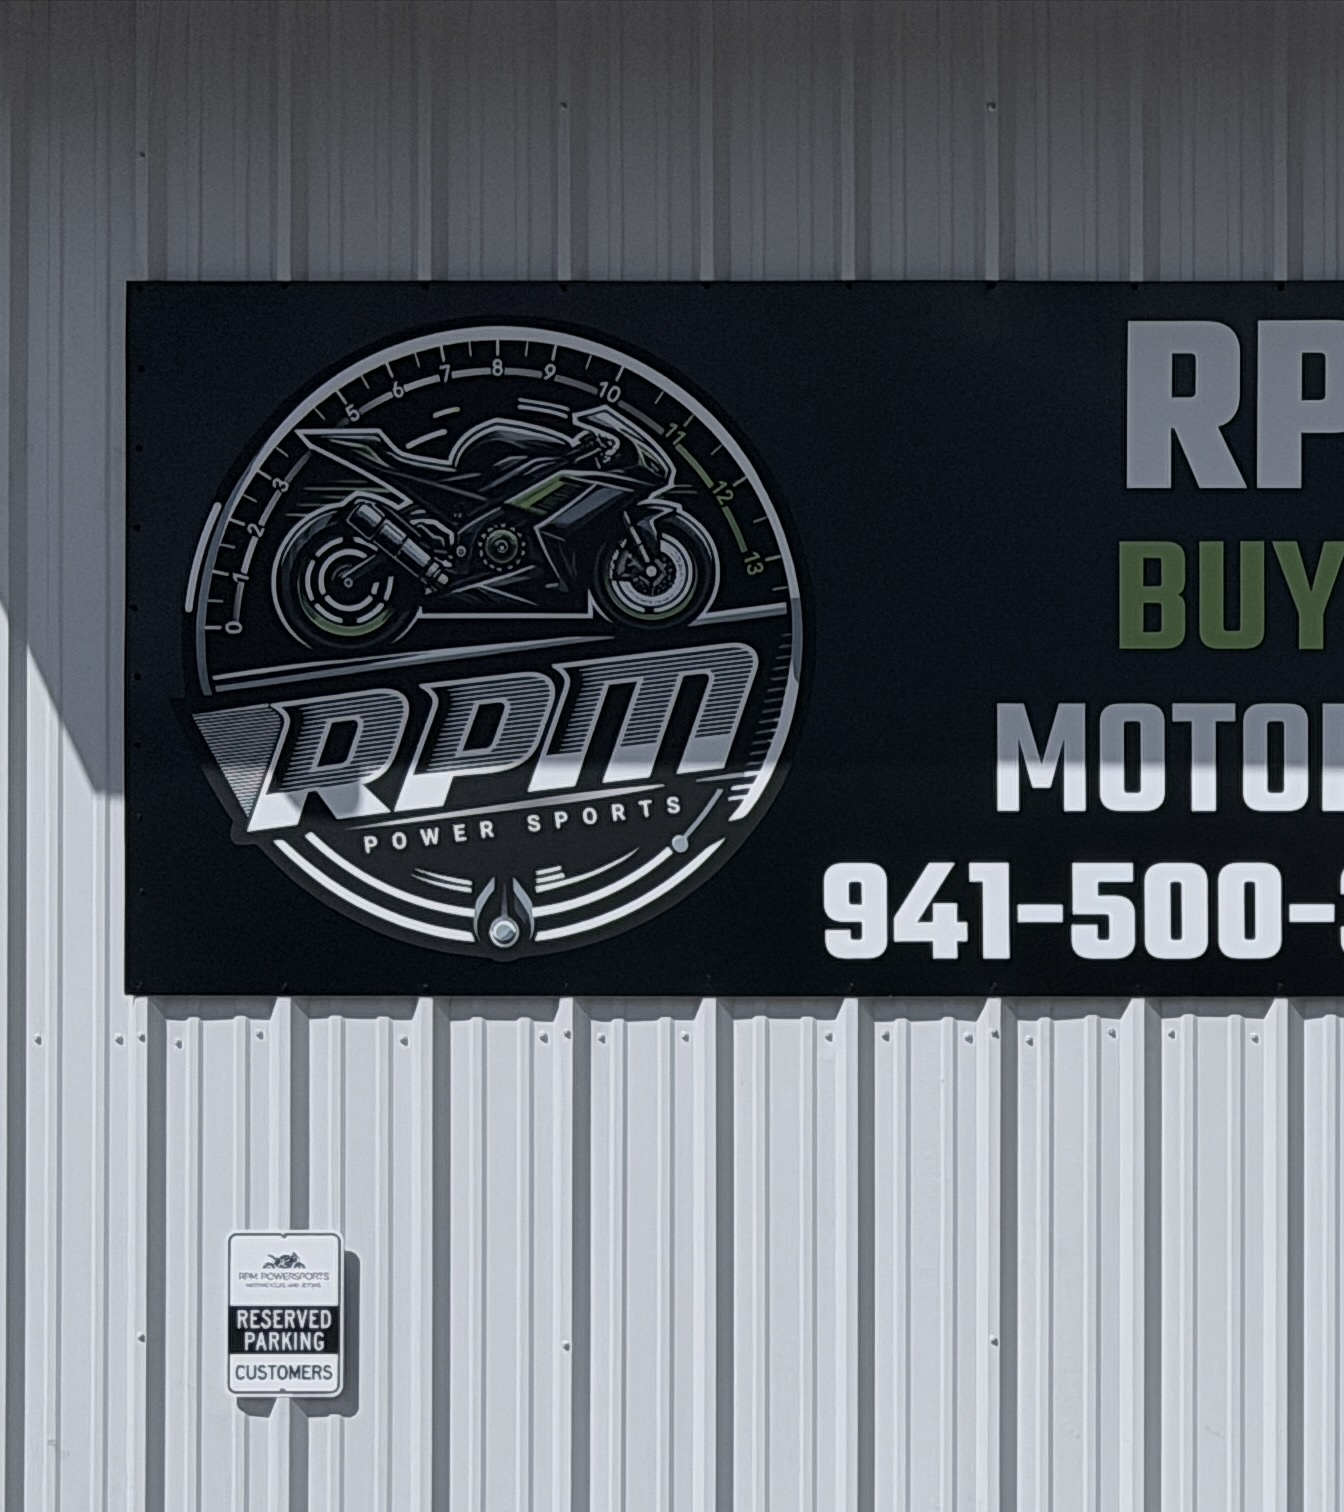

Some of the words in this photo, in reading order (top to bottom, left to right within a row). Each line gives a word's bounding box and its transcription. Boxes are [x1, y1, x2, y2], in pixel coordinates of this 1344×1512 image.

[439, 364, 451, 382] 7
[492, 358, 504, 377] 8
[543, 363, 557, 381] 9
[392, 381, 404, 398] 6
[599, 381, 622, 403] 10
[345, 404, 361, 422] 5
[665, 422, 687, 445] 11
[272, 477, 290, 493] 3
[712, 480, 734, 505] 12
[247, 522, 265, 539] 2
[743, 551, 765, 576] 13
[232, 572, 249, 583] 1
[225, 620, 243, 634] 0
[247, 643, 760, 832] RPM
[362, 819, 496, 855] POWER
[527, 794, 682, 833] SPORTS
[261, 1271, 330, 1281] POWERSPORTS
[236, 1309, 332, 1330] RESERVED
[244, 1331, 325, 1351] PARKING
[235, 1364, 333, 1380] CUSTOMERS
